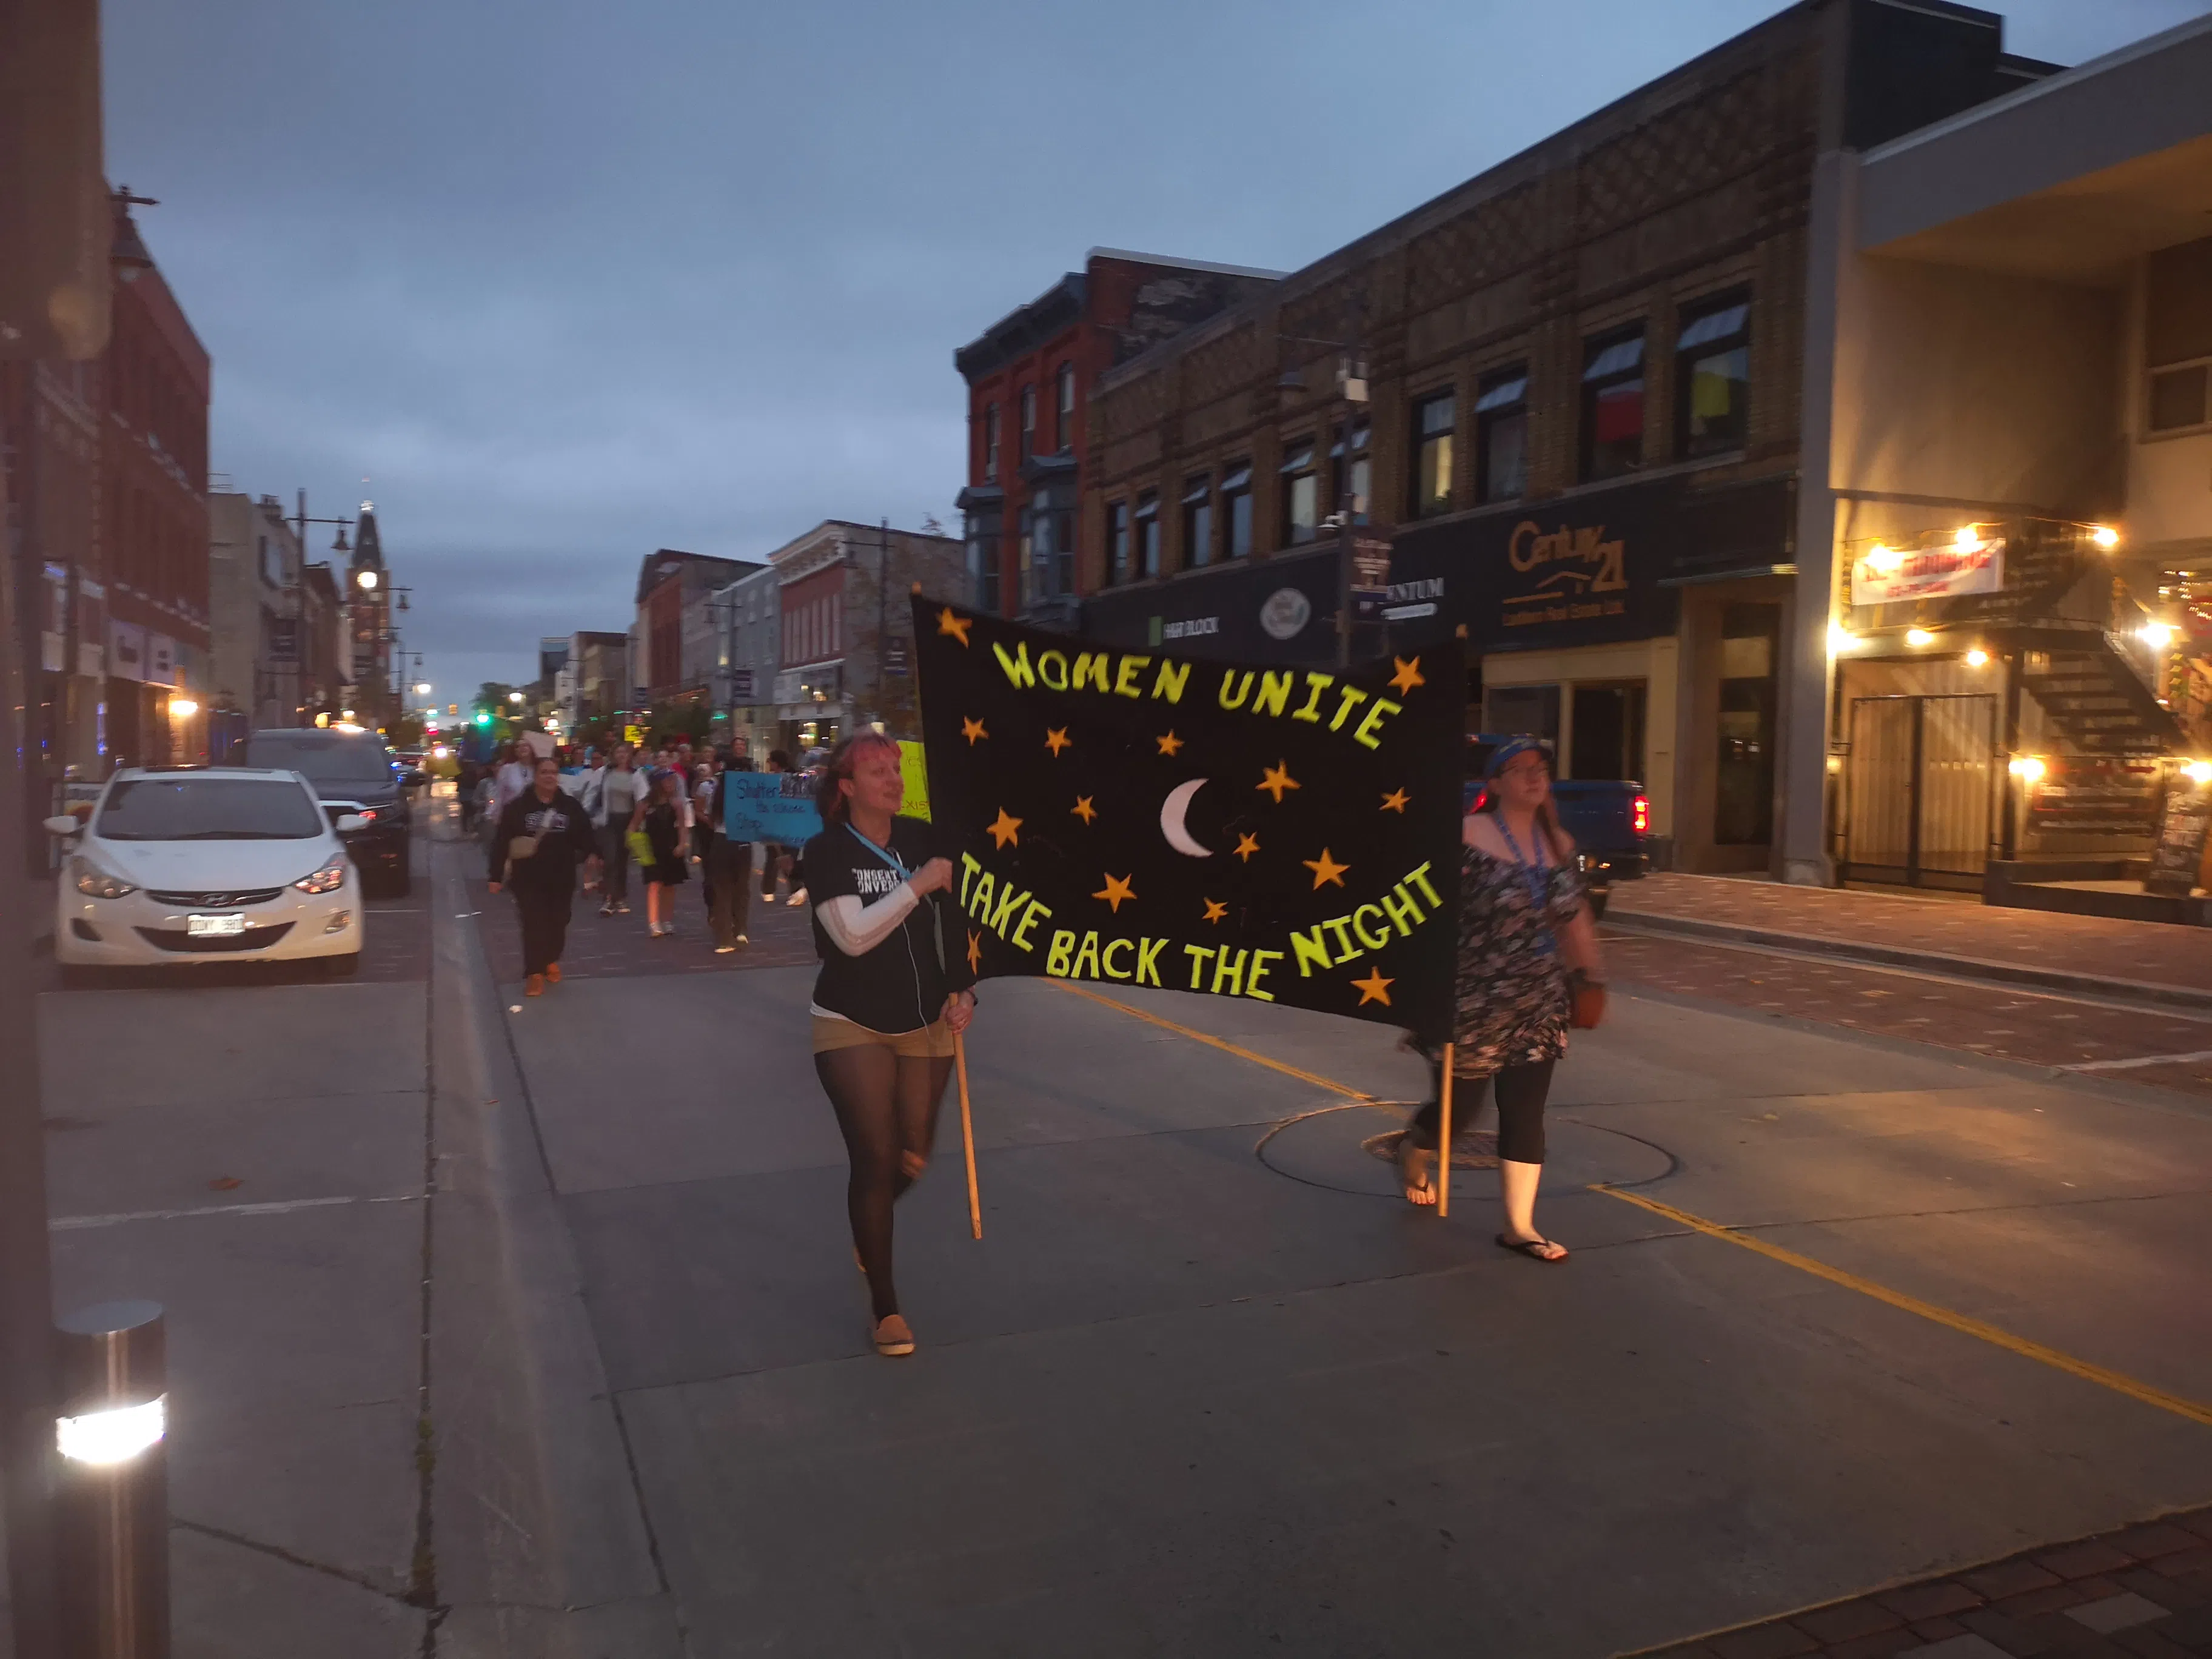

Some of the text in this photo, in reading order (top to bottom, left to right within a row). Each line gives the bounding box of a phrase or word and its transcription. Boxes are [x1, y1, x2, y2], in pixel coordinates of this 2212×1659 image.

[1509, 521, 1631, 592] Century 21
[1185, 616, 1219, 637] BLOCK
[993, 641, 1403, 751] WOMEN UNITE
[901, 800, 930, 810] XIST
[857, 879, 900, 894] ONVER
[960, 851, 1444, 1002] TAKE BACK THE NIGHT
